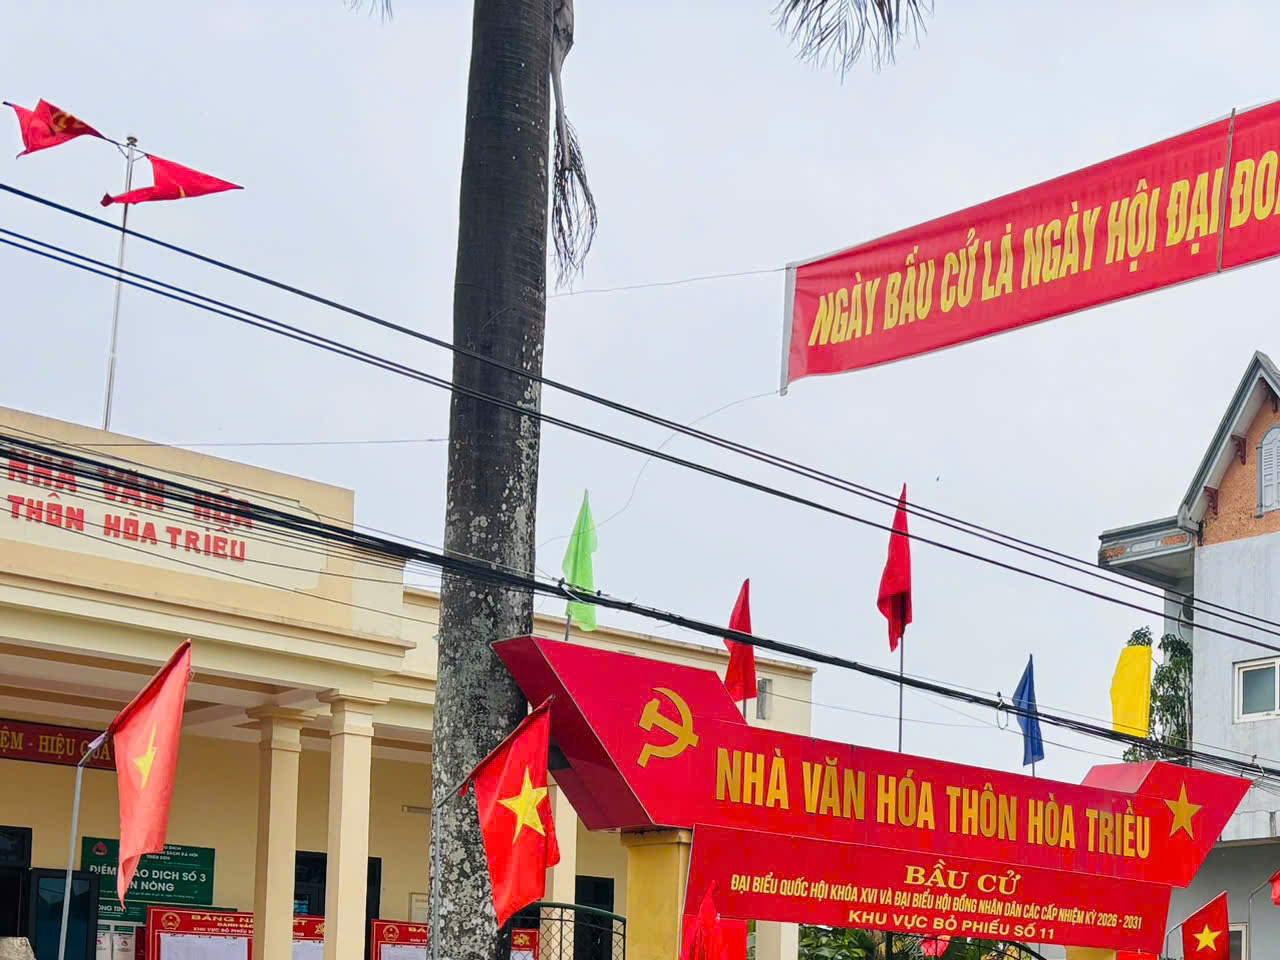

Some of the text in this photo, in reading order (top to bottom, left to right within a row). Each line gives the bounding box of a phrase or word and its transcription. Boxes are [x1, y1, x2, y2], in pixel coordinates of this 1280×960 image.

[808, 271, 881, 346] NGÀY
[883, 245, 935, 330] BẦU
[941, 227, 980, 313] CỬ
[981, 223, 1013, 301] LÀ
[1021, 201, 1102, 290] NGÀY
[1105, 178, 1160, 272] HỘI
[1165, 167, 1224, 255] ĐẠI
[8, 492, 84, 531] THÔN
[39, 733, 76, 759] HIỆU
[715, 747, 1150, 859] NHÀ VĂN HÓA THÔN HÒA TRIỀU
[152, 869, 179, 881] DỊCH
[182, 871, 197, 882] SỐ
[199, 873, 207, 883] 3
[904, 859, 1022, 896] BẦU CỬ
[191, 913, 234, 922] BẢNG
[731, 873, 750, 894] ĐẠI
[752, 871, 777, 894] BIỂU
[780, 876, 808, 897] QUỐC
[810, 880, 828, 901] HỘI
[830, 883, 858, 902] KHÓA
[860, 887, 878, 904] XVI
[879, 887, 893, 905] VÀ
[894, 890, 910, 909] ĐẠI
[912, 889, 934, 909] BIỂU
[935, 893, 952, 911] HỘI
[952, 893, 977, 913] ĐỒNG
[978, 898, 1003, 916] NHÂN
[1004, 900, 1022, 918] DÂN
[1023, 903, 1040, 920] CÁC
[1041, 903, 1058, 921] CẤP
[1059, 907, 1084, 926] NHIỆM
[1085, 910, 1097, 926] KỲ
[1097, 914, 1117, 928] 2026
[1124, 915, 1143, 930] 2031
[849, 910, 1055, 940] KHU VỰC BỎ PHIẾU SỐ 11
